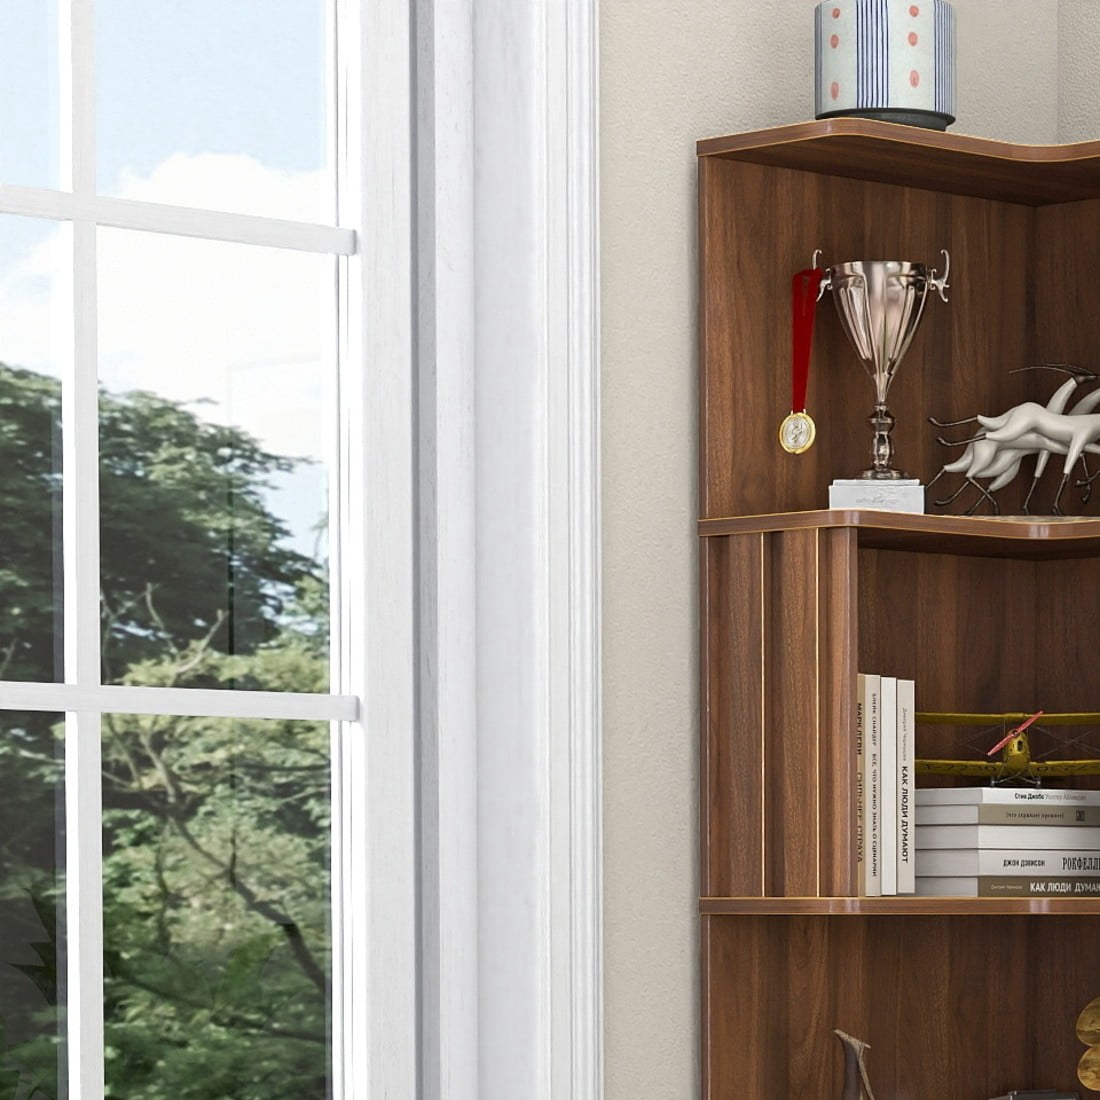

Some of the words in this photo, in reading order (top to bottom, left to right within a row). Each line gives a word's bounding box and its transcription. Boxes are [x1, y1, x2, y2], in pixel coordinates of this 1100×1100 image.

[901, 766, 909, 785] КАК
[901, 787, 909, 818] ЛЮДИ
[901, 820, 909, 864] ДУМАЮТ
[1029, 882, 1046, 892] КАК
[1047, 882, 1071, 893] ЛЮДИ
